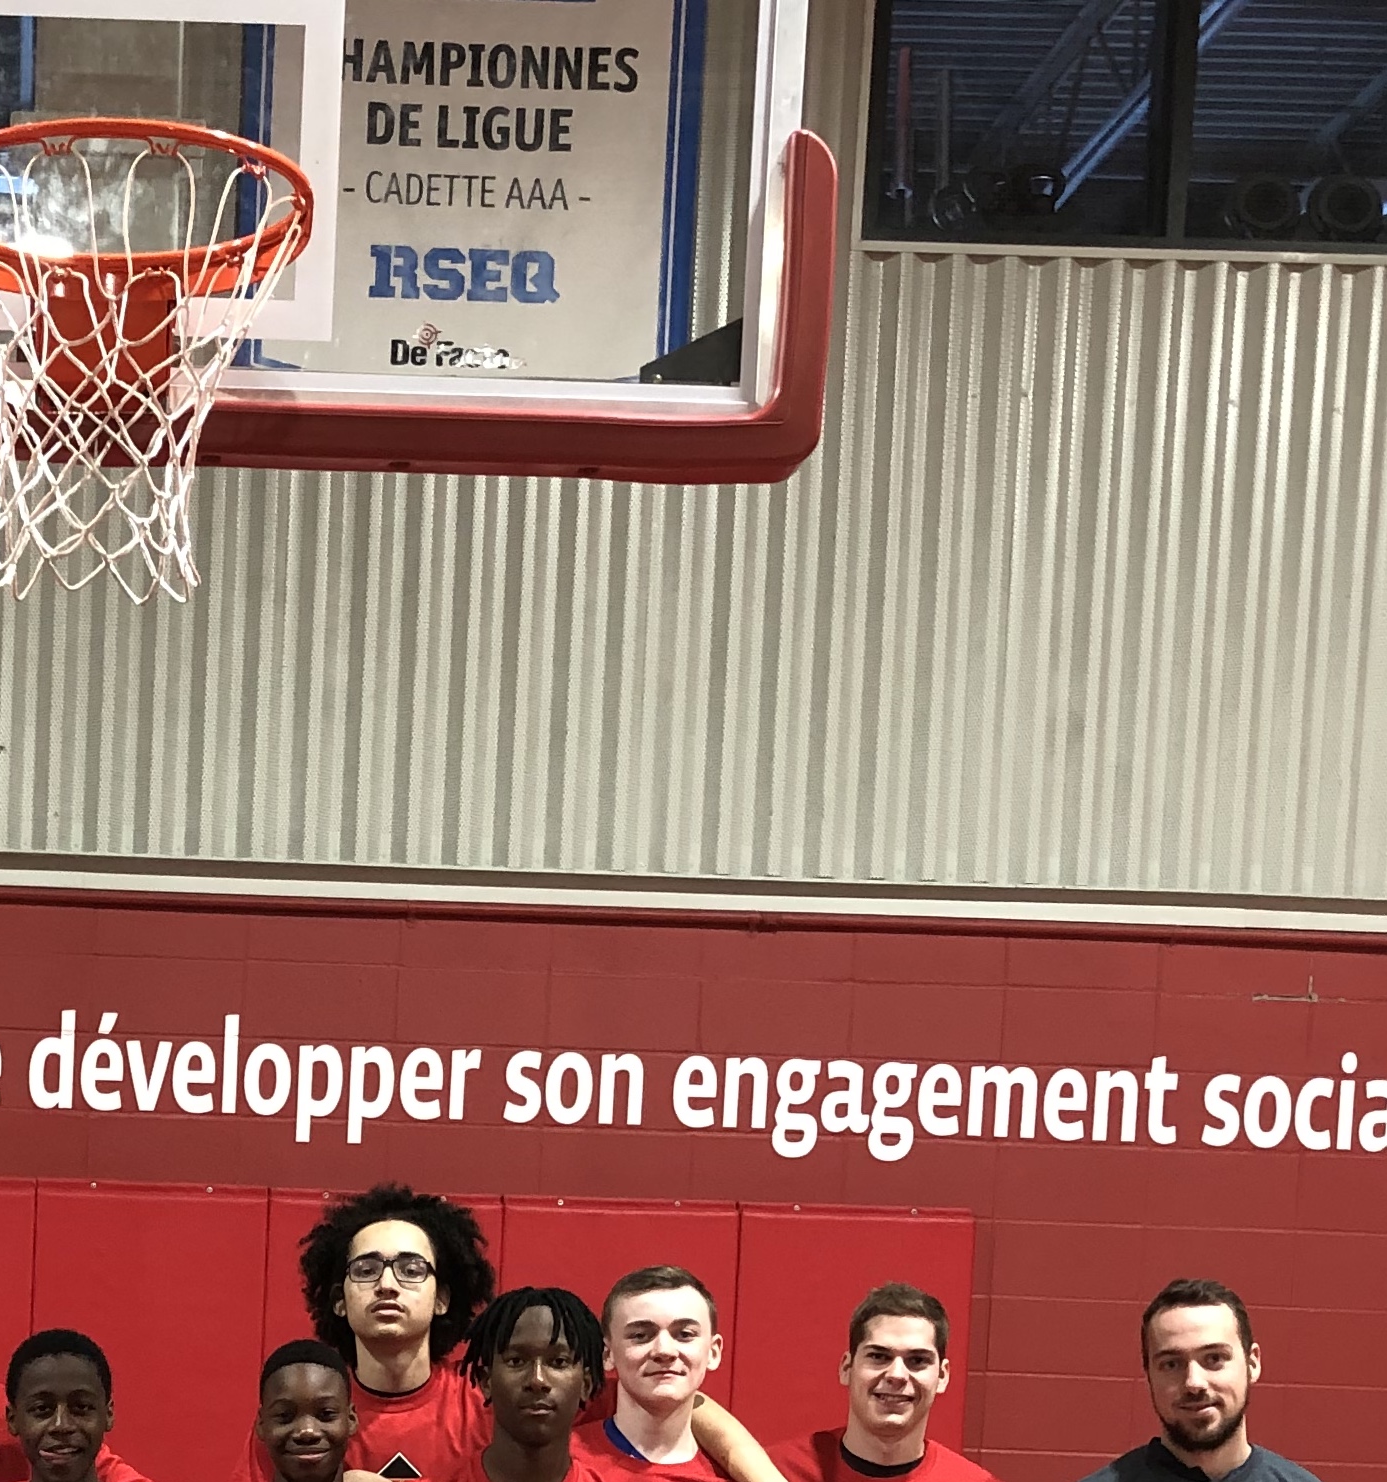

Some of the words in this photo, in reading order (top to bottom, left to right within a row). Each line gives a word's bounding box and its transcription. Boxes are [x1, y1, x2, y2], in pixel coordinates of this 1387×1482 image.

[342, 38, 640, 93] HAMPIONNES
[366, 101, 423, 148] DE
[437, 104, 574, 152] LIGUE
[365, 170, 497, 208] CADETTE
[505, 177, 570, 211] AAA
[368, 244, 561, 304] RSEQ
[389, 338, 428, 366] De
[28, 1009, 482, 1144] développer
[502, 1049, 644, 1126] son
[672, 1052, 1178, 1162] engagement
